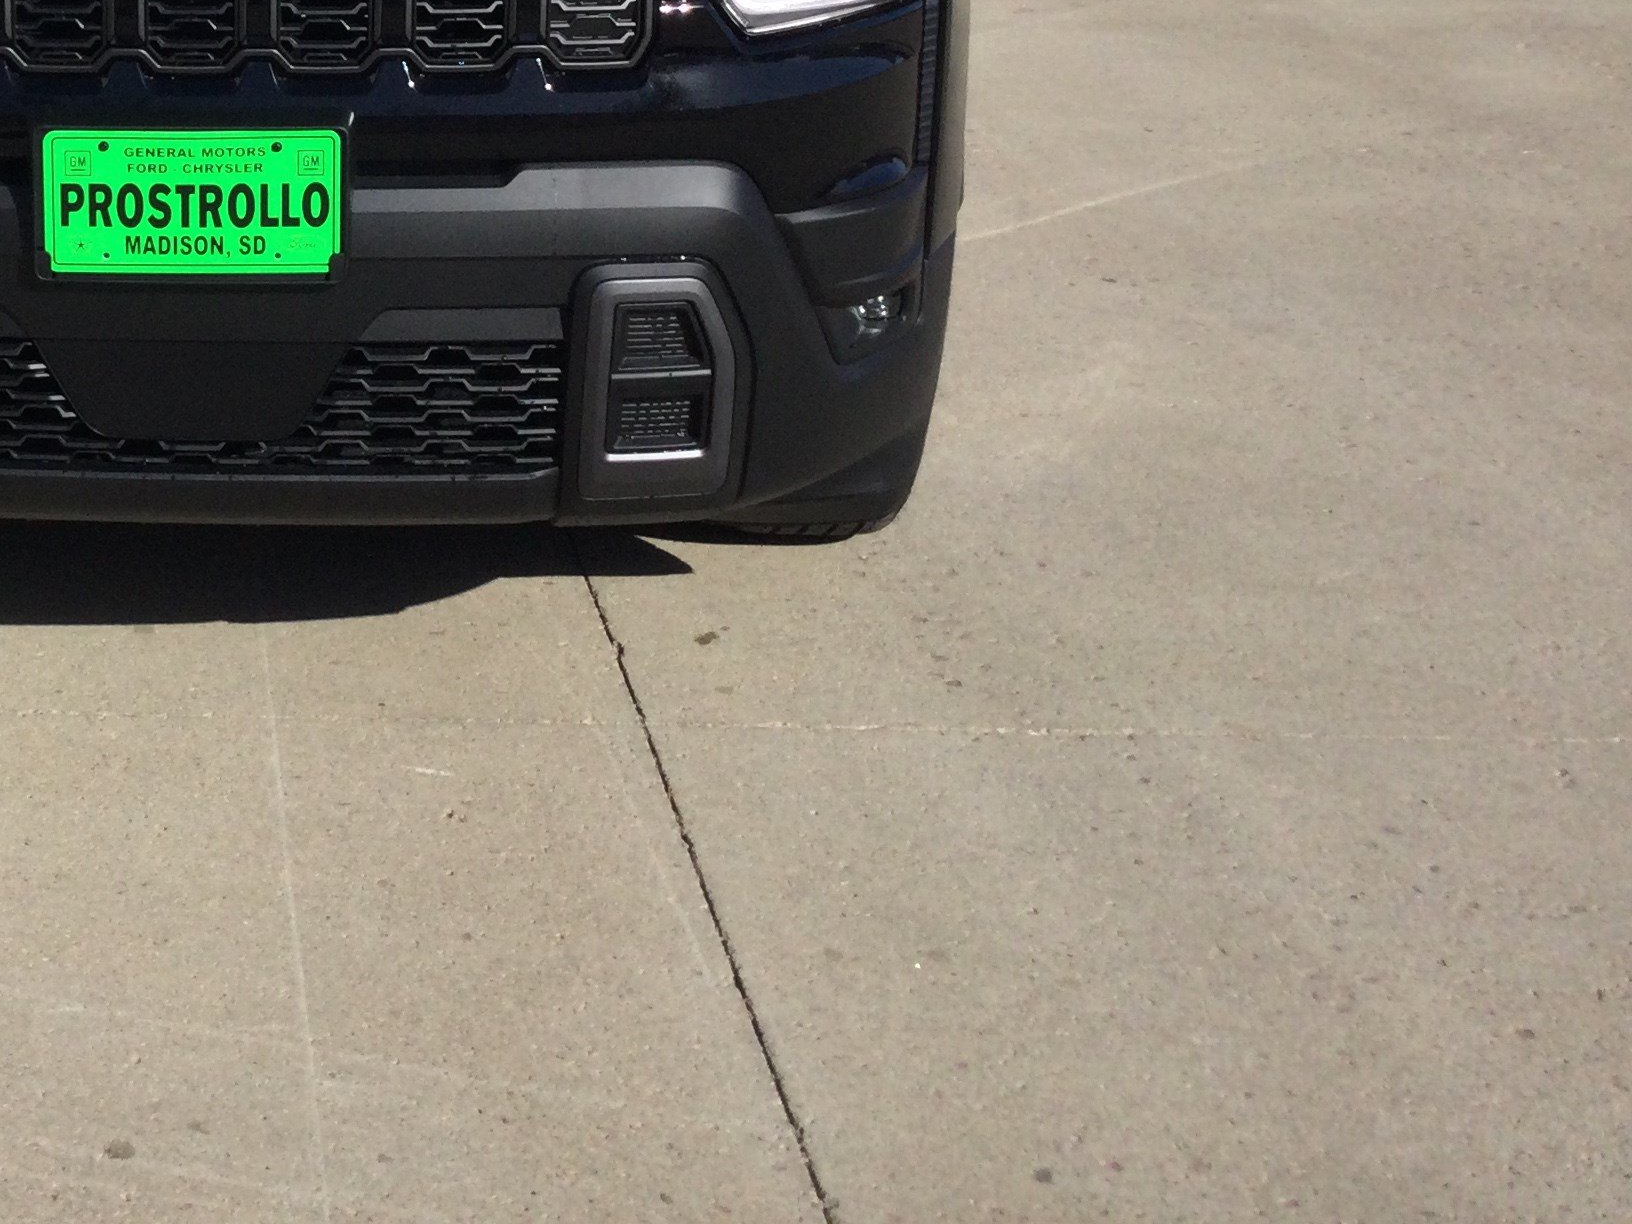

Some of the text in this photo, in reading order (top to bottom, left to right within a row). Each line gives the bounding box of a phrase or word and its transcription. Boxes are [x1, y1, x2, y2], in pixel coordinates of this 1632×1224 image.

[123, 146, 267, 159] GENERAL MOTORS
[69, 155, 87, 168] GM
[126, 163, 168, 174] FORD
[183, 162, 264, 174] CHRYSLER
[302, 155, 321, 168] GM
[59, 181, 331, 230] PROSTROLLO
[124, 235, 267, 258] MADISON, SD
